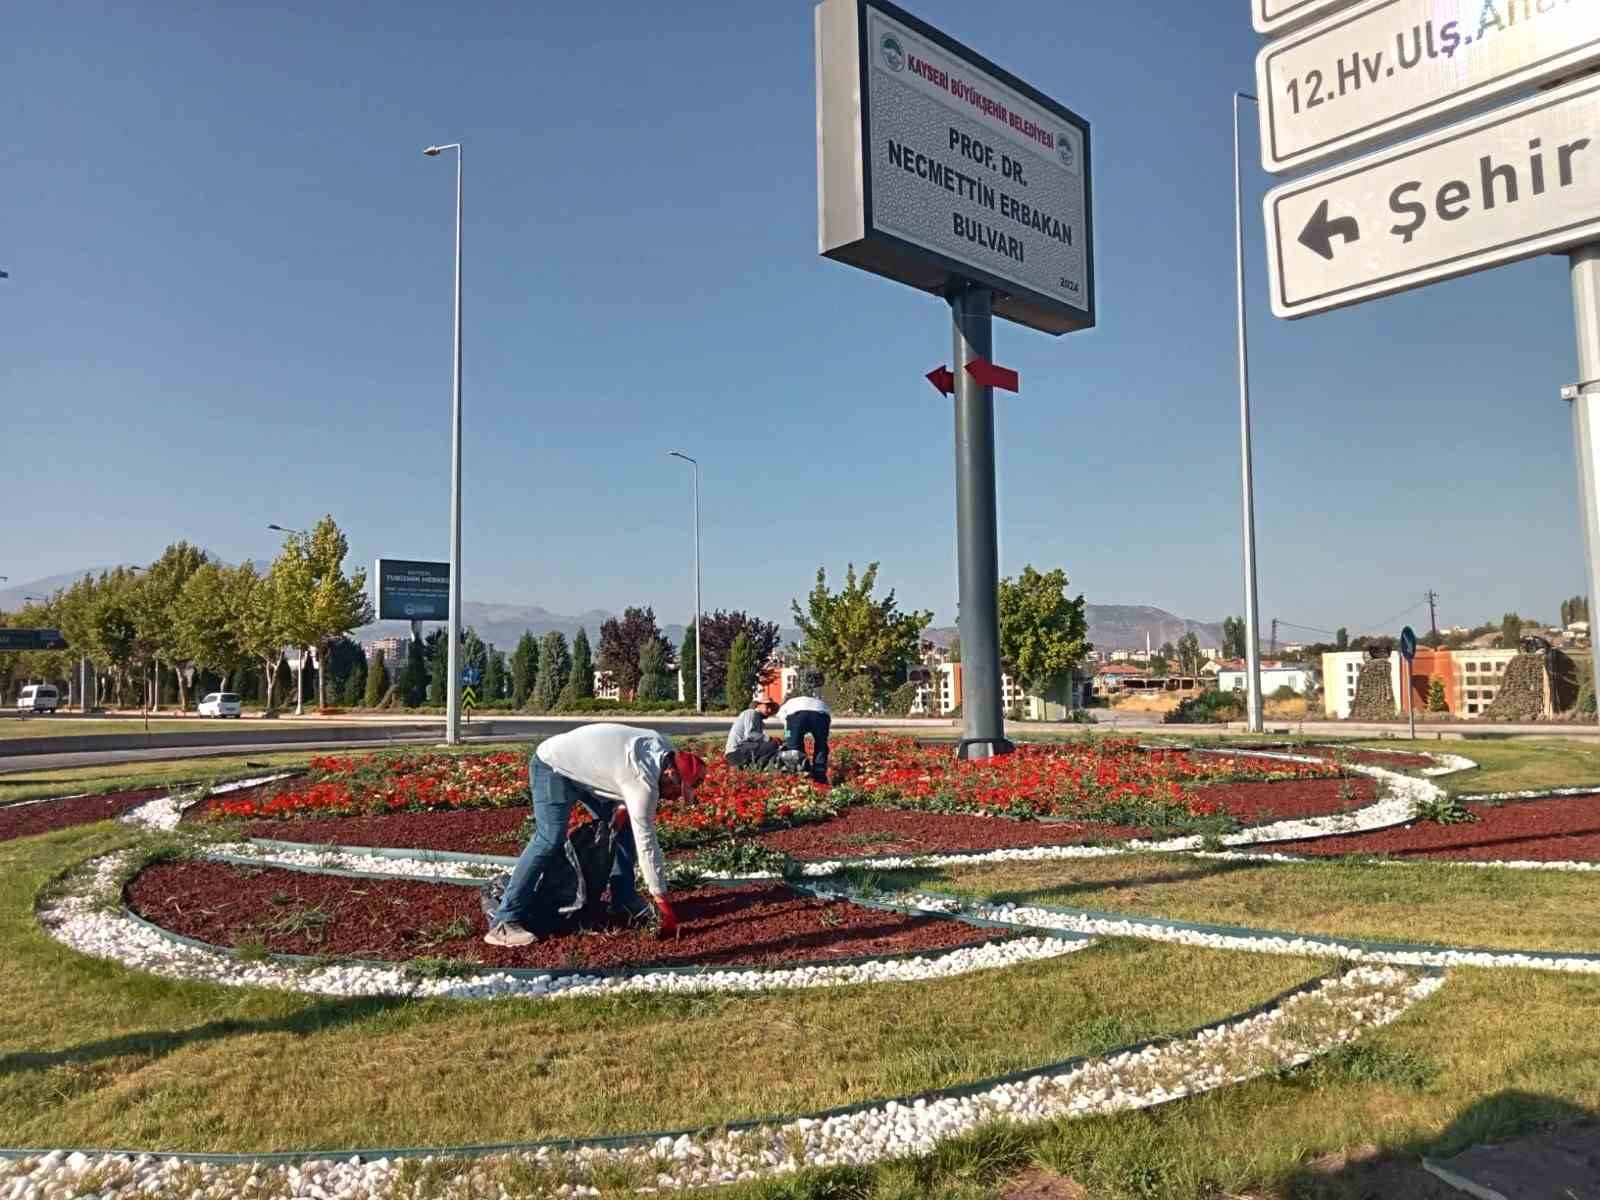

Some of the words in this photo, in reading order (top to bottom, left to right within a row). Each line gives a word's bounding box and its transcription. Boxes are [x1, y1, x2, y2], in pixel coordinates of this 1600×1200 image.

[908, 53, 949, 90] KAYSERİ
[951, 79, 1008, 124] BÜYÜKŞEHİR
[1009, 111, 1054, 150] BELEDİYESİ
[888, 139, 995, 211] NECMETTİN
[999, 193, 1073, 247] ERBAKAN
[949, 127, 997, 171] PROF.
[1001, 154, 1028, 187] DR.
[1388, 137, 1591, 244] Şehir
[953, 212, 1025, 263] BULVARI
